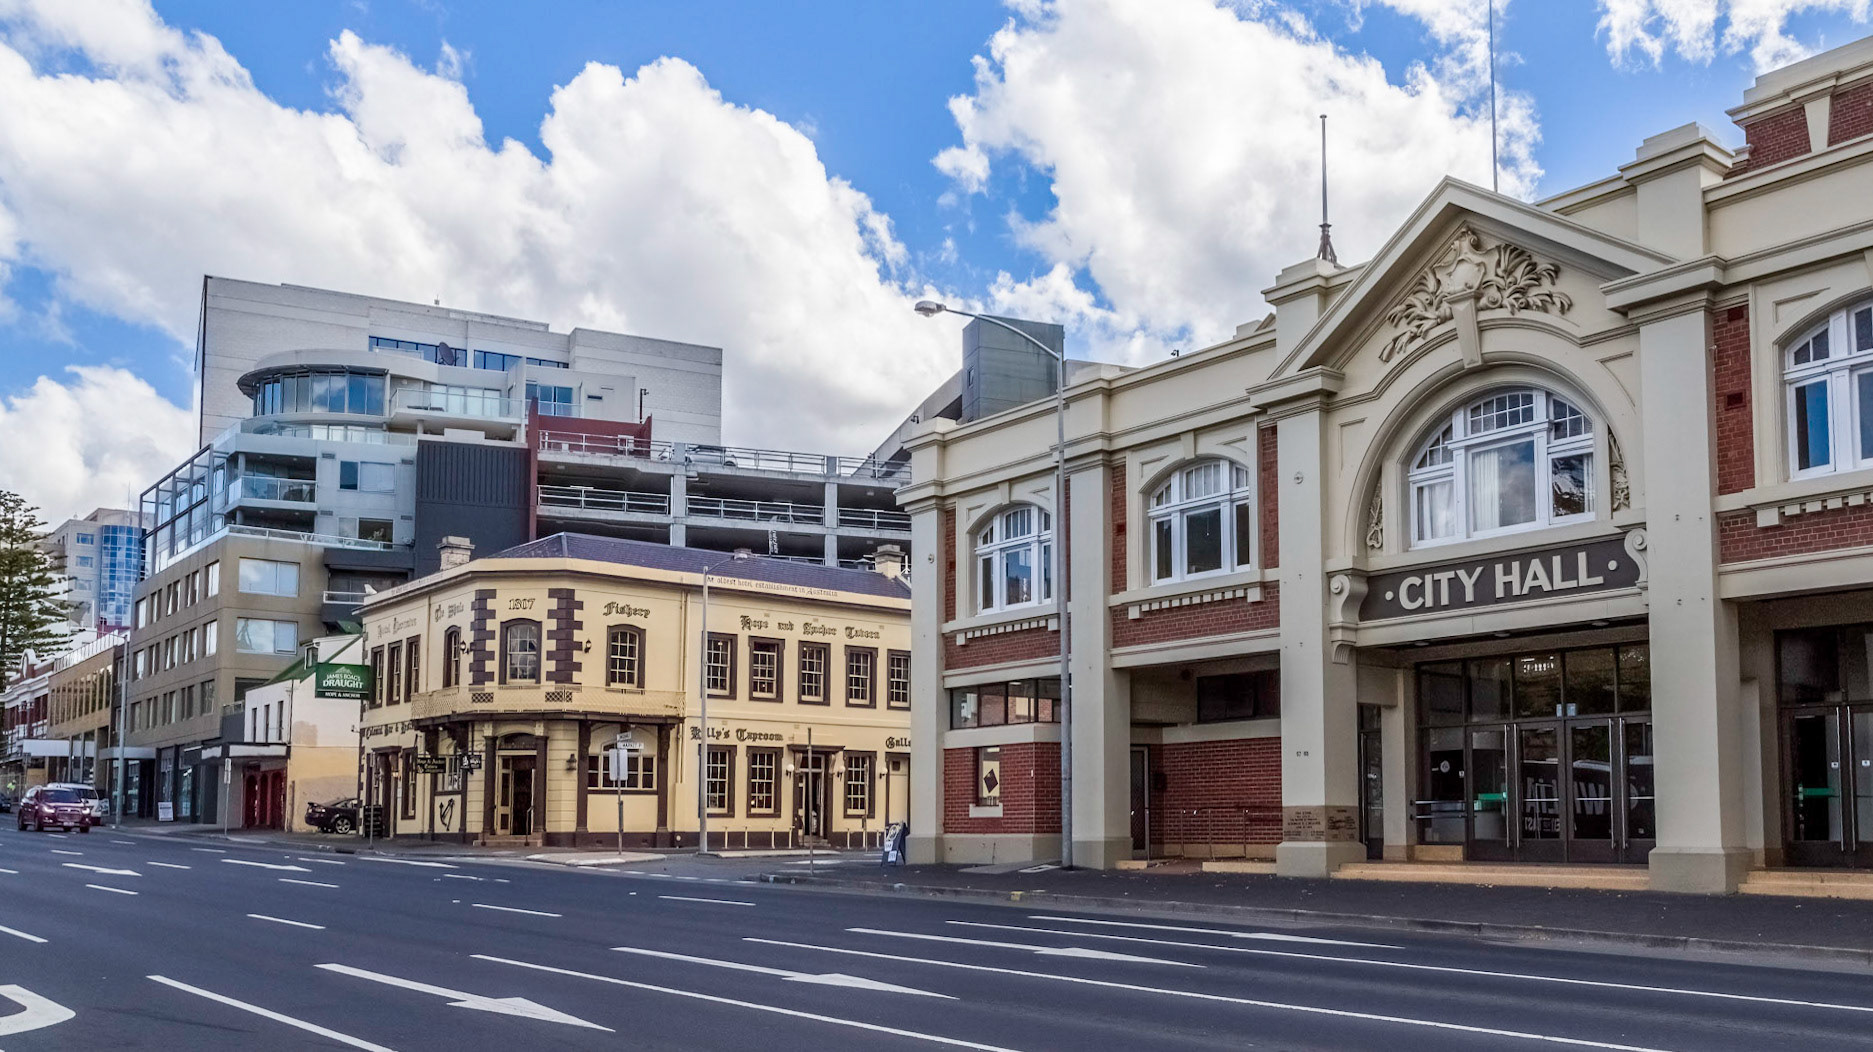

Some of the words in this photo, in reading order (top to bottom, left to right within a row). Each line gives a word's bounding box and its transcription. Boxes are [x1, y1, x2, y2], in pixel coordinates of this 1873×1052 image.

[1399, 566, 1484, 610] CITY
[1495, 552, 1604, 599] HALL
[806, 587, 838, 597] Australia
[508, 597, 536, 610] 1807
[603, 601, 650, 619] Fishery
[740, 615, 769, 631] Hope
[777, 620, 794, 631] and
[803, 622, 837, 636] Anchor
[845, 626, 880, 639] Tavern
[322, 679, 364, 689] DRAUGHT
[343, 674, 361, 682] BOAG'S
[690, 726, 730, 741] Klly's
[735, 728, 784, 743] Taproom
